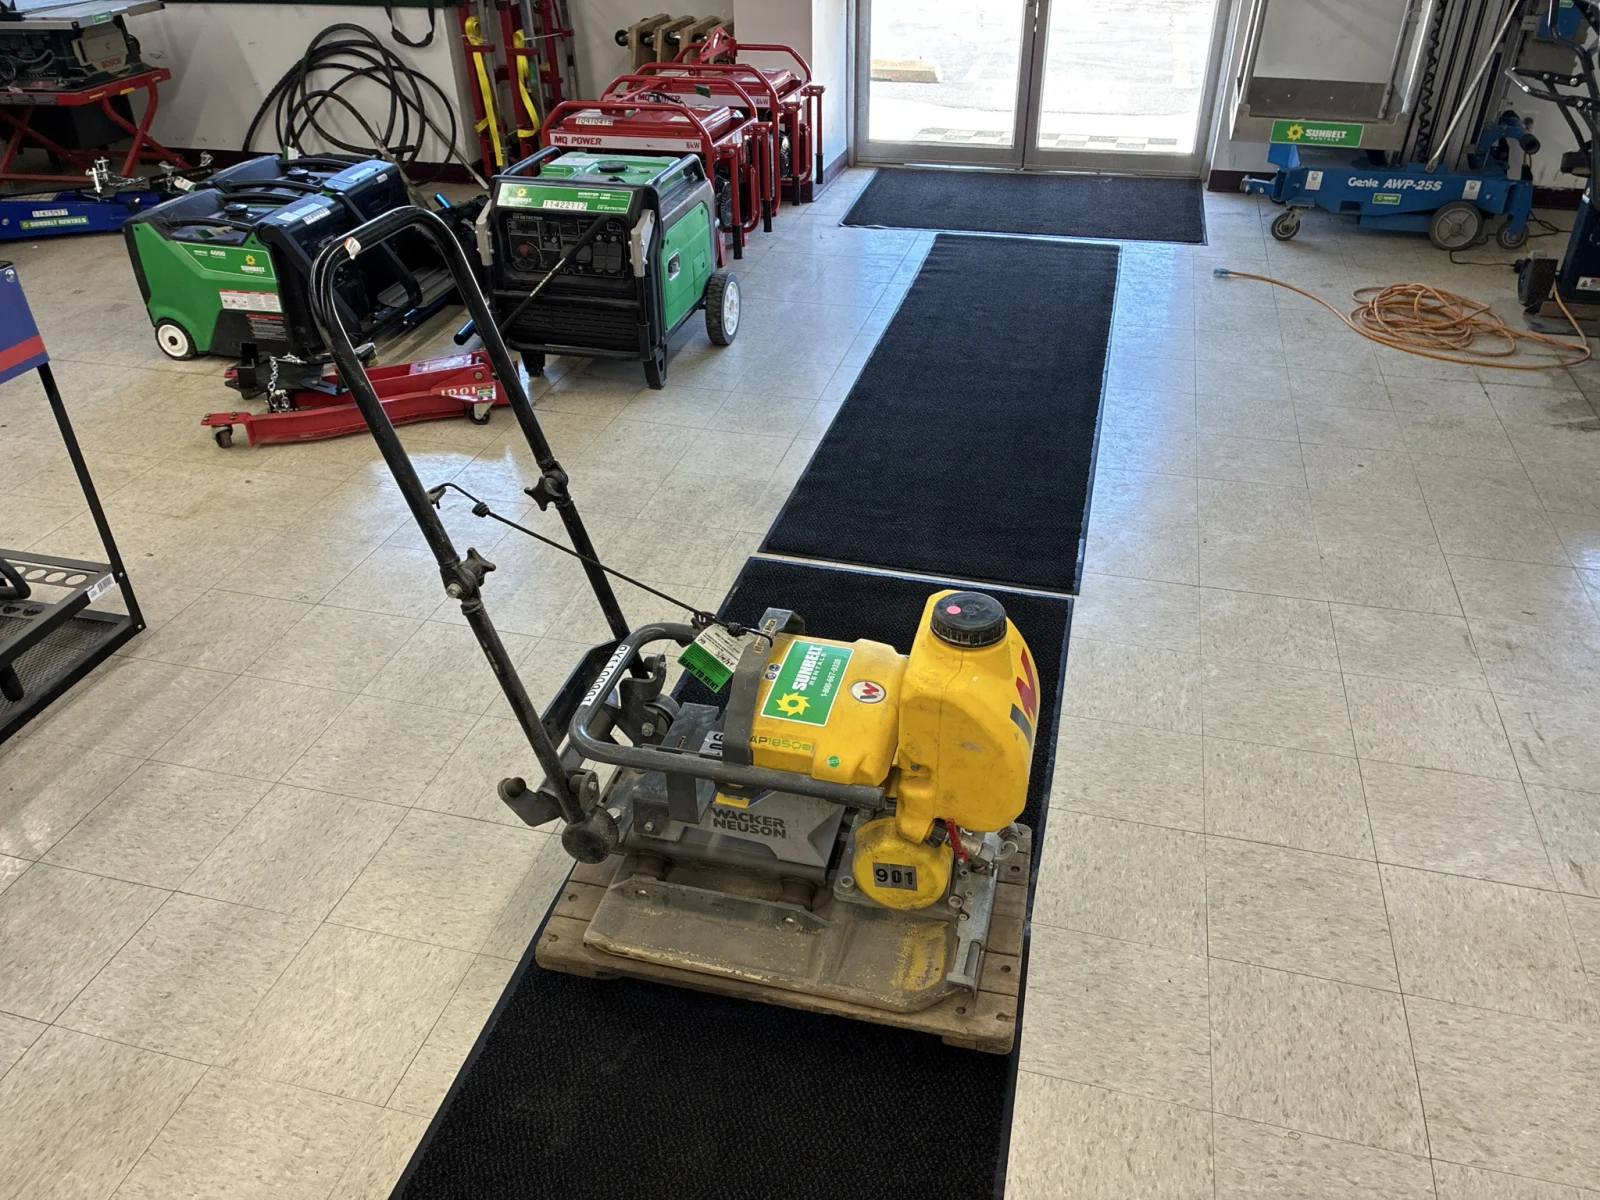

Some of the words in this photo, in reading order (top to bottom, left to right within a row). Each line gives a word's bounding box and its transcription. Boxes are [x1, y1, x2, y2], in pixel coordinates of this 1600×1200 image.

[554, 135, 568, 146] MQ
[571, 136, 602, 146] POWER
[1305, 128, 1348, 139] SUNBELT
[686, 141, 700, 149] 6kW
[1348, 177, 1379, 188] Genie
[1383, 178, 1443, 192] AWP-25S
[680, 656, 697, 672] READY
[703, 674, 719, 690] RENT
[792, 645, 823, 691] SUNBELT
[809, 652, 827, 686] RENTALS
[711, 807, 786, 829] WACKER
[713, 818, 787, 839] NEUSON
[875, 868, 913, 885] 901
